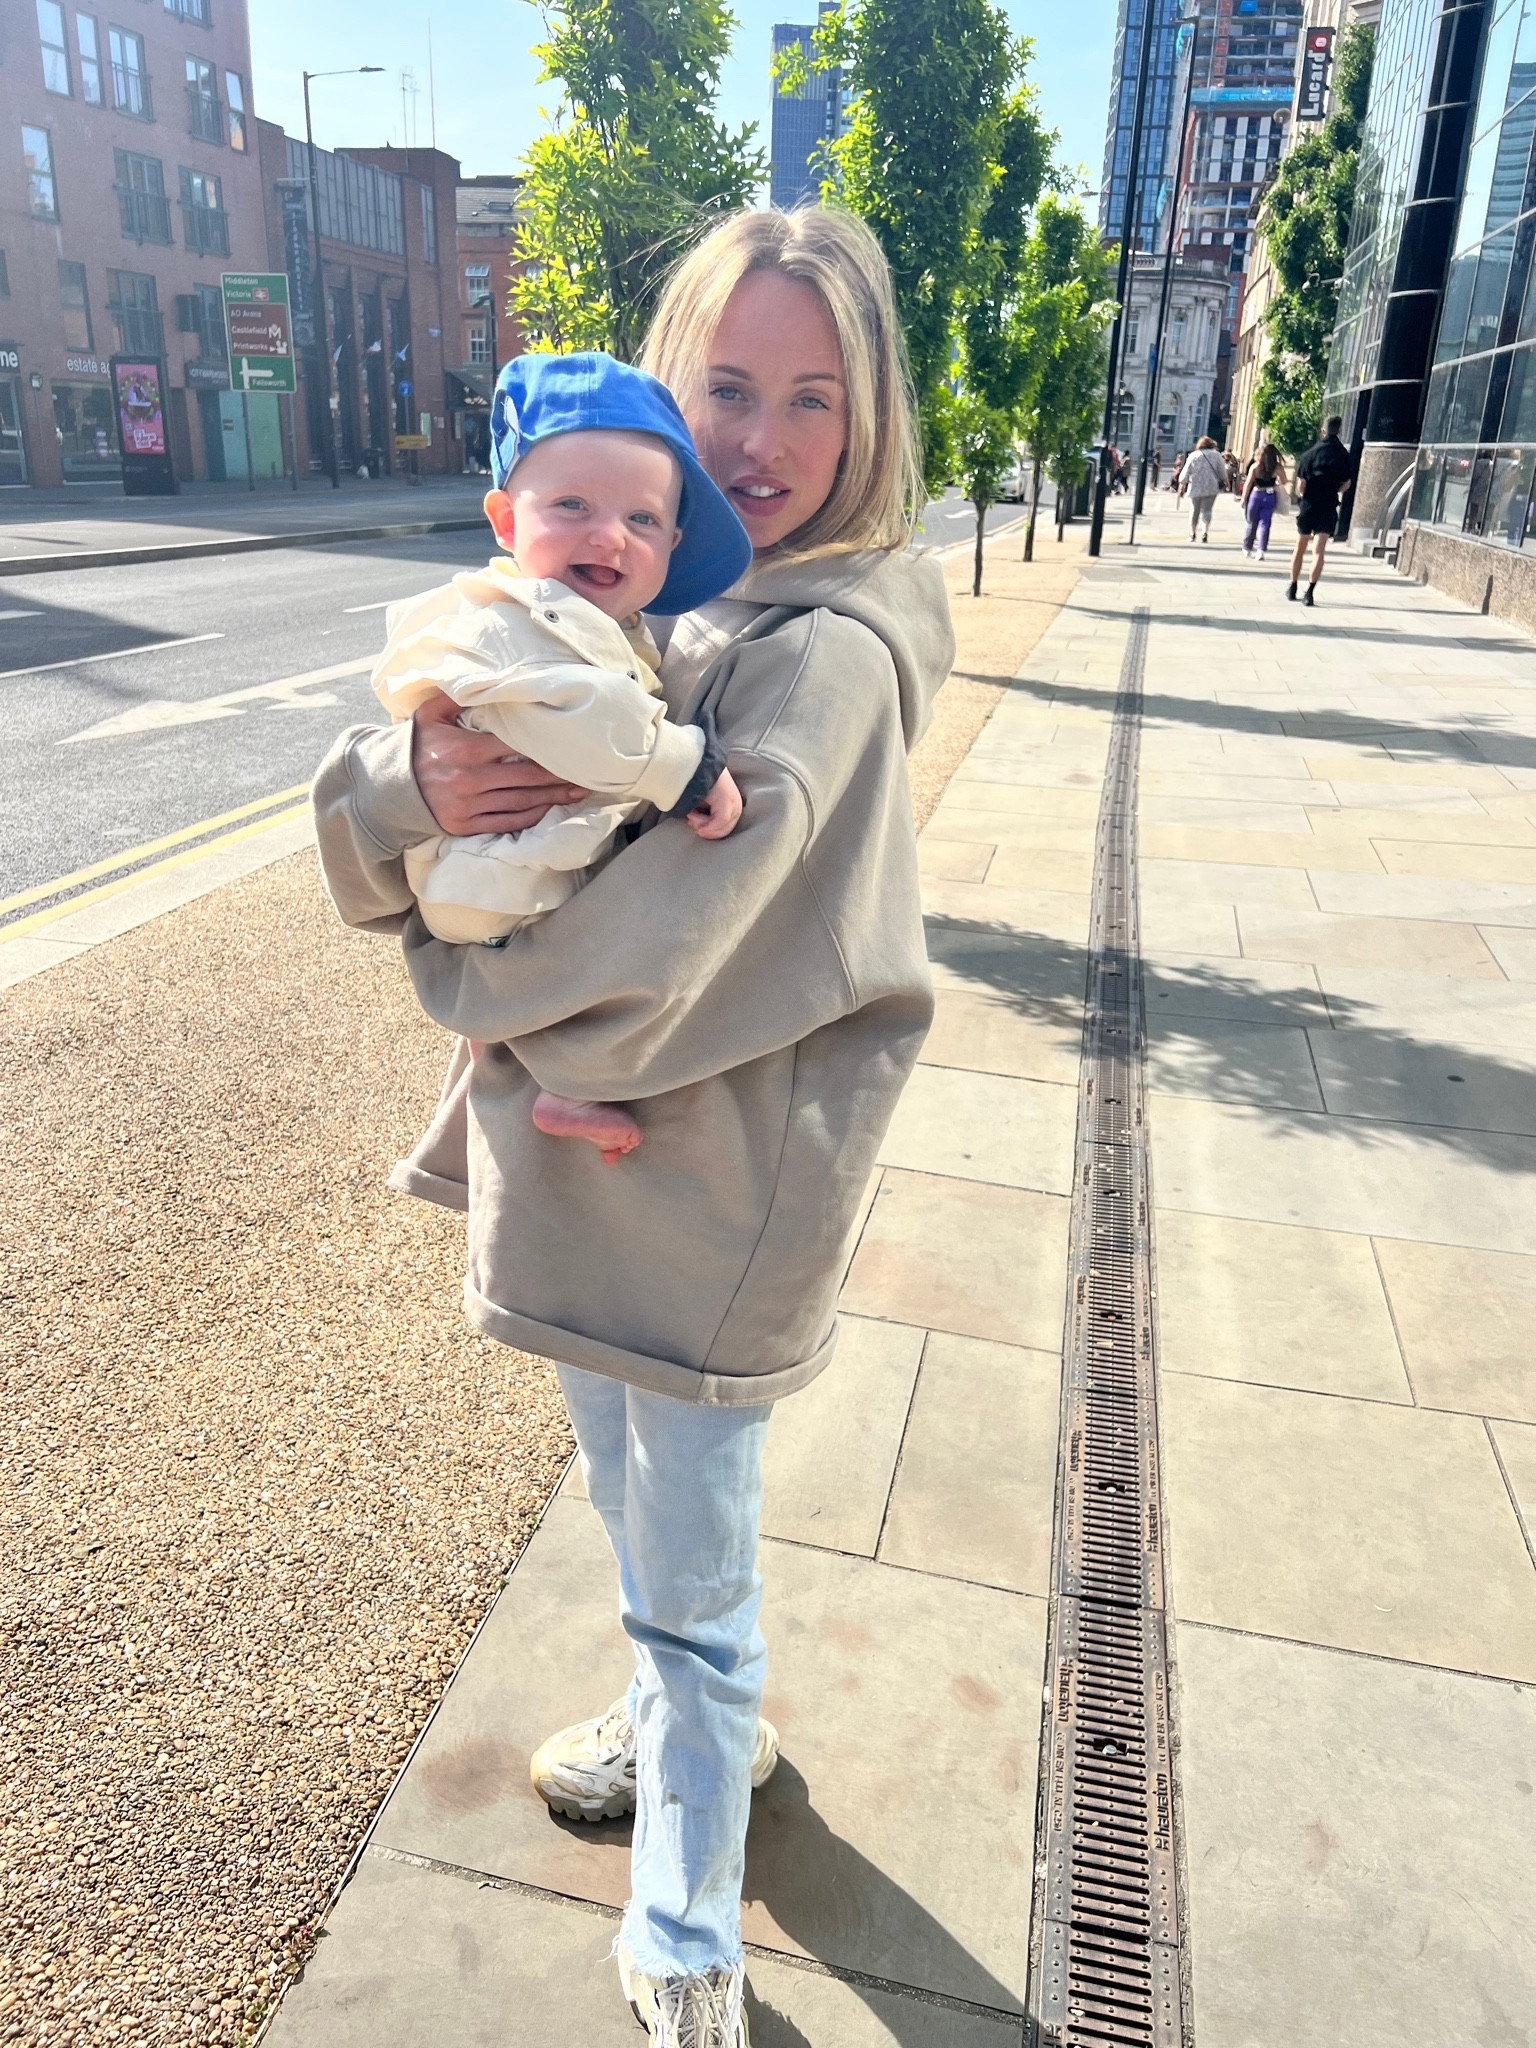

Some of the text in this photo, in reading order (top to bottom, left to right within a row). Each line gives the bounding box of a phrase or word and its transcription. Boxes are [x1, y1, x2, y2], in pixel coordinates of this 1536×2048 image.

[1300, 37, 1327, 116] Lucardo
[224, 276, 259, 285] Middleton
[225, 289, 252, 298] Victoria
[230, 309, 262, 318] AO Arena
[231, 325, 268, 335] Castlefield
[233, 342, 268, 350] Printworks
[67, 357, 98, 373] estate
[252, 378, 287, 387] Failsworth
